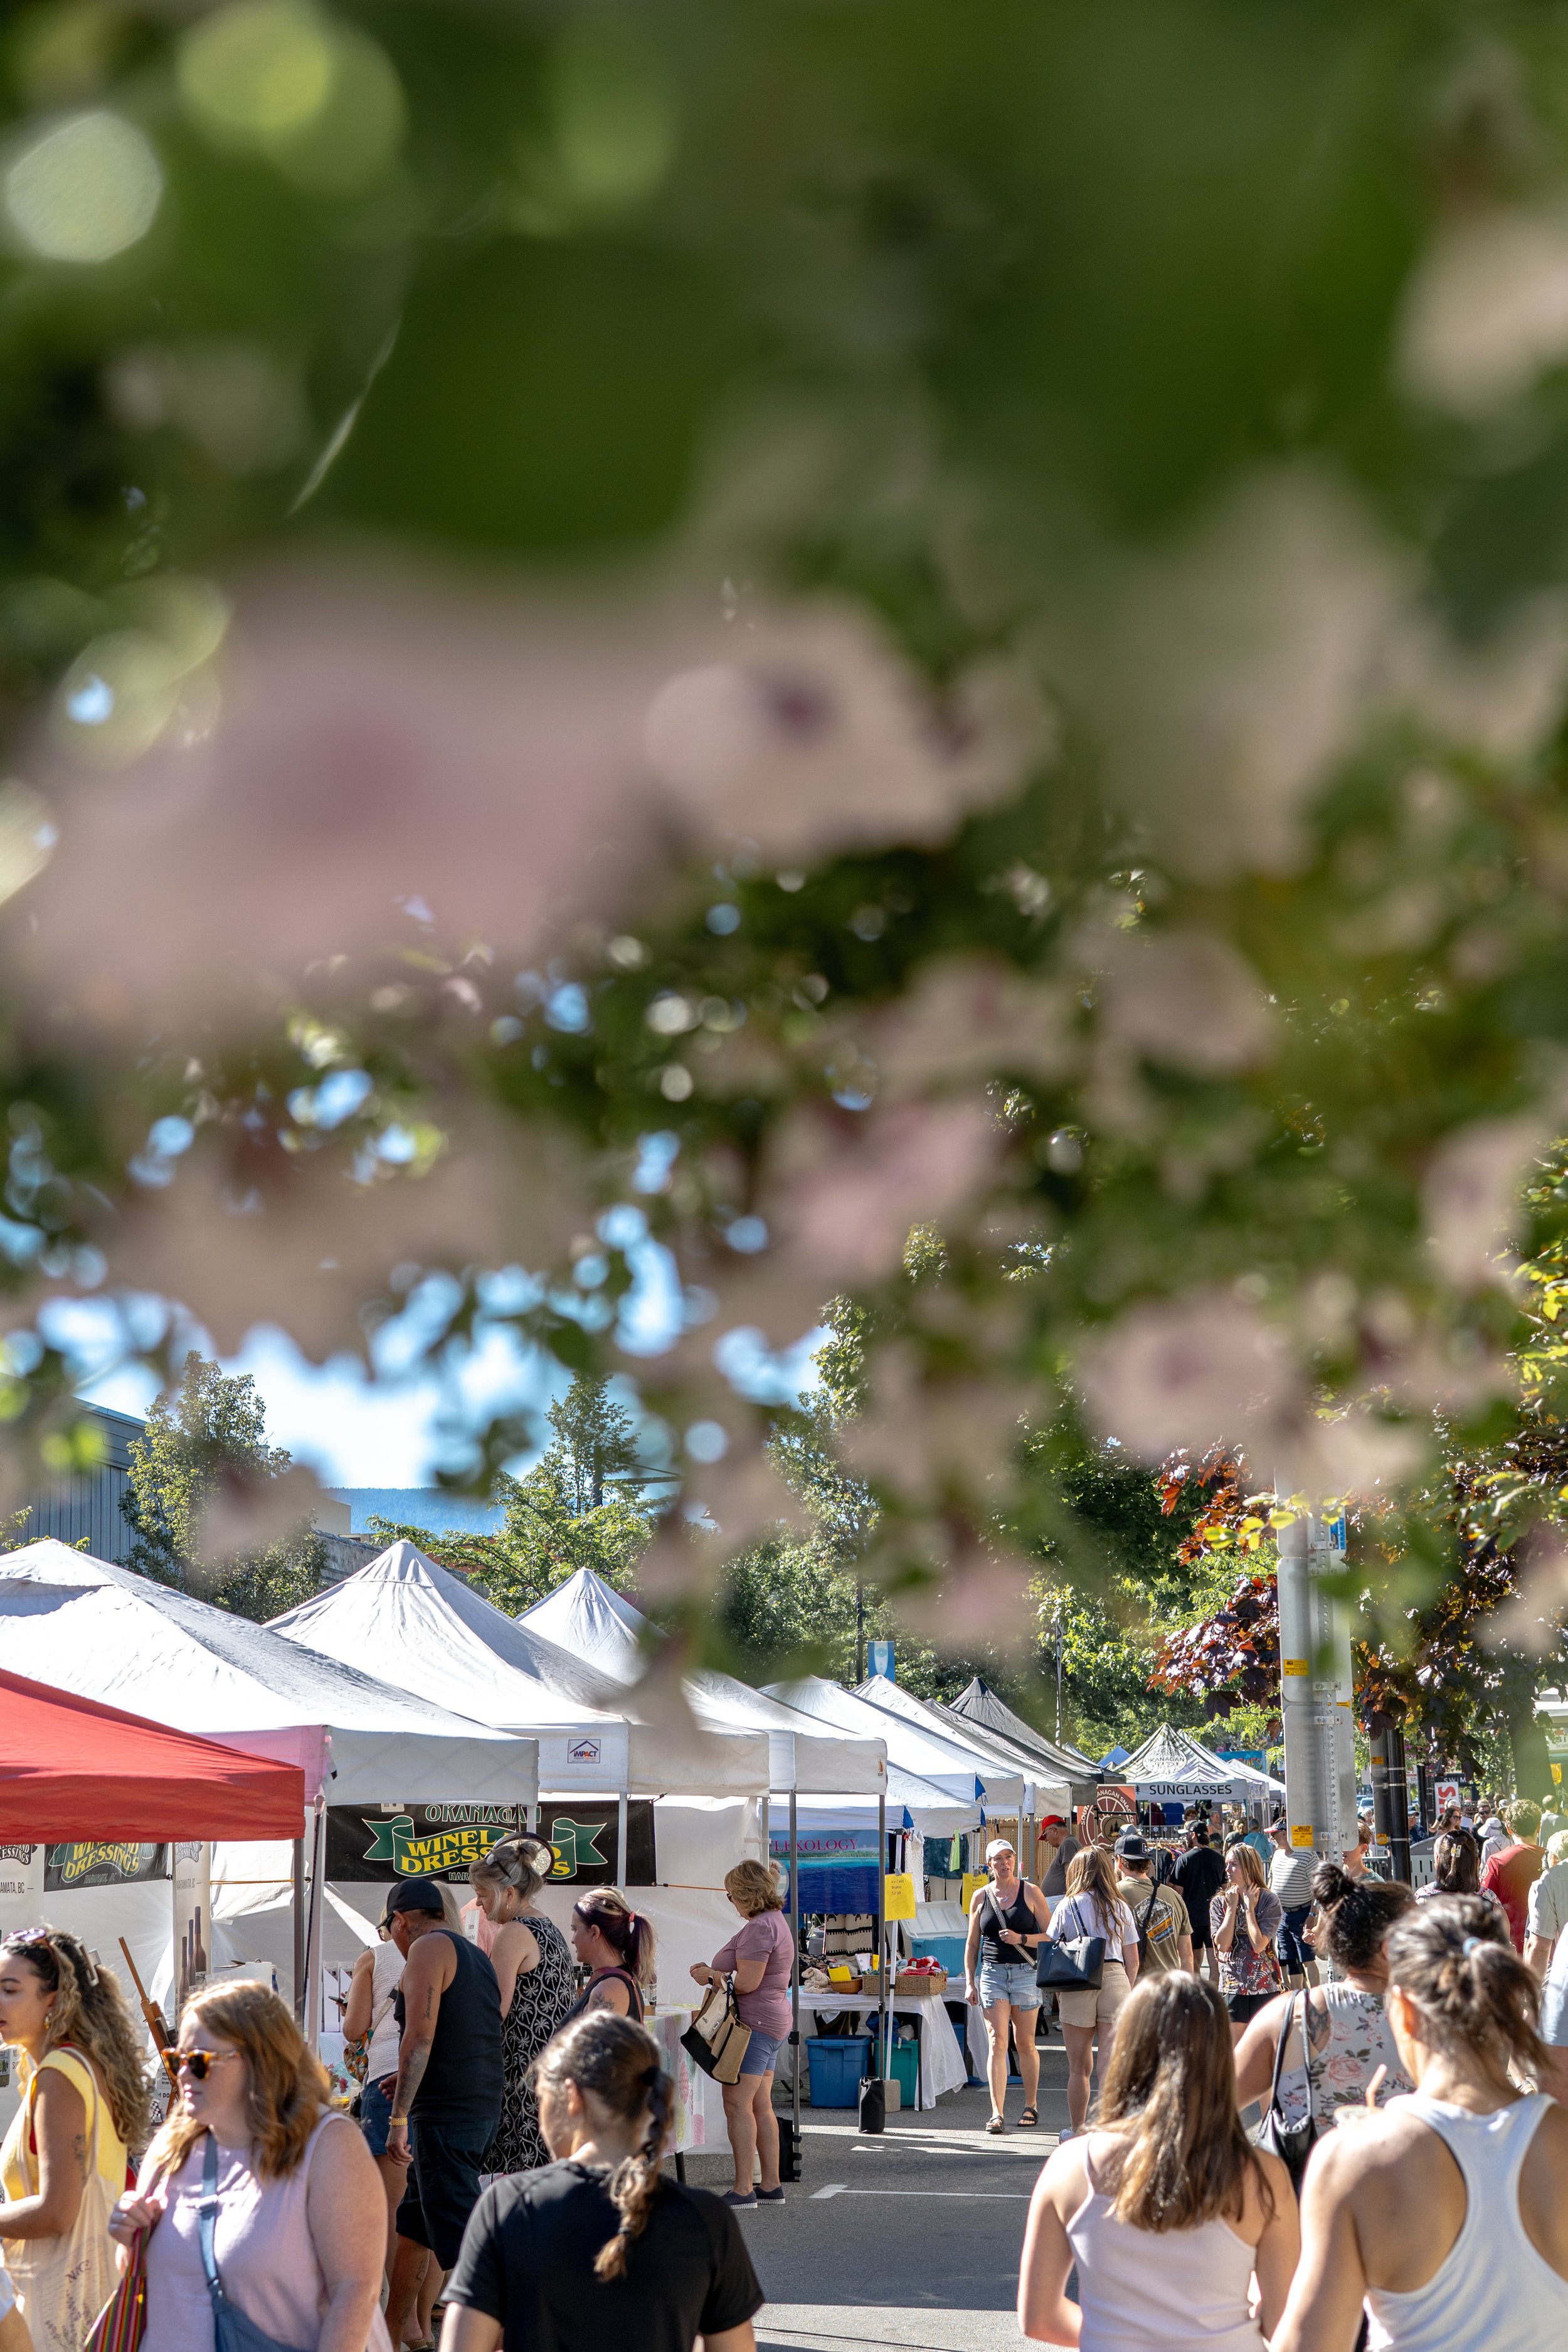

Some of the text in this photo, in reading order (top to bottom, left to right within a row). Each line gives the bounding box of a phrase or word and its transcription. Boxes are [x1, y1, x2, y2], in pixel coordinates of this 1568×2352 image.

[1097, 1789, 1120, 1799] ANAGAN
[1150, 1784, 1232, 1795] SUNGLASSES
[0, 1847, 29, 1864] ESSINGS
[65, 1845, 140, 1878] DRESSINGS
[18, 1882, 24, 1894] BC
